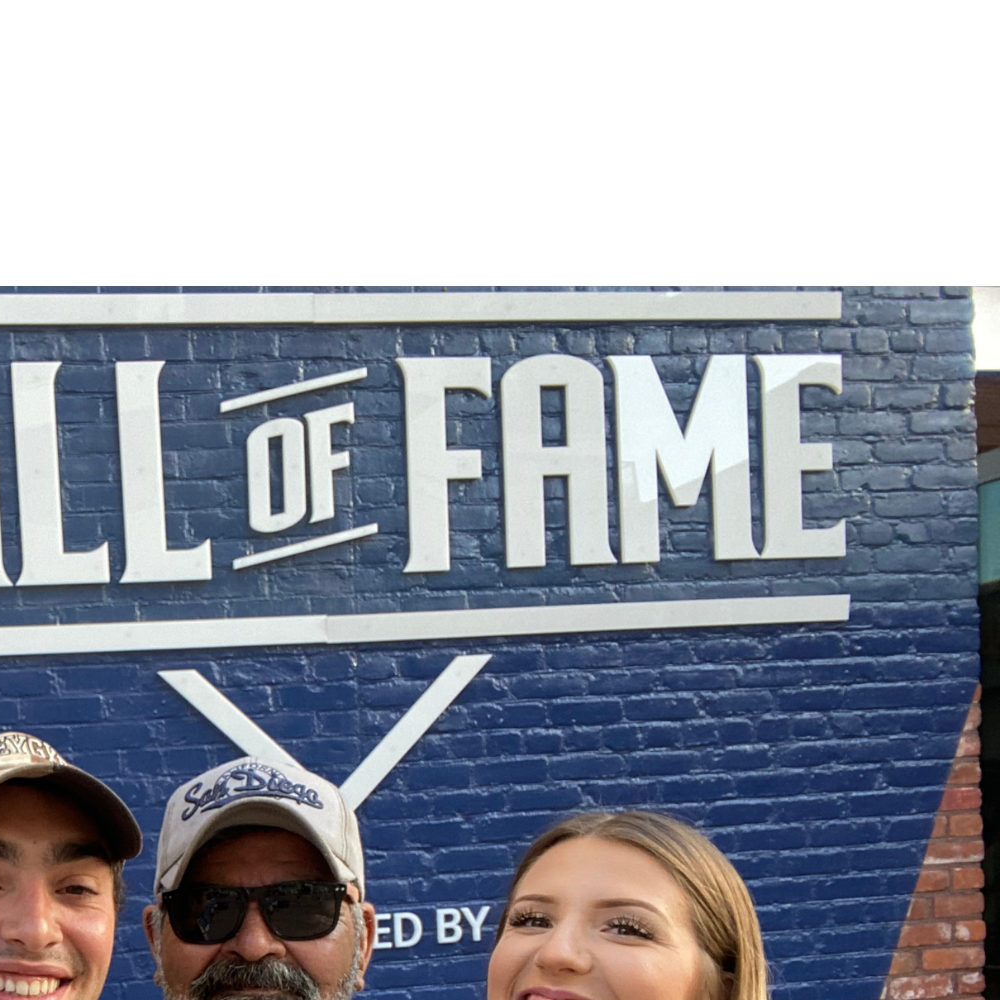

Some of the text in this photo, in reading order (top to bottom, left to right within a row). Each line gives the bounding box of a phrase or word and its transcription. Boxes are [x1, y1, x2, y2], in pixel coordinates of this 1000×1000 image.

[246, 401, 355, 534] OF
[396, 353, 847, 574] FAME
[181, 768, 323, 821] San Diego
[436, 905, 491, 944] BY
